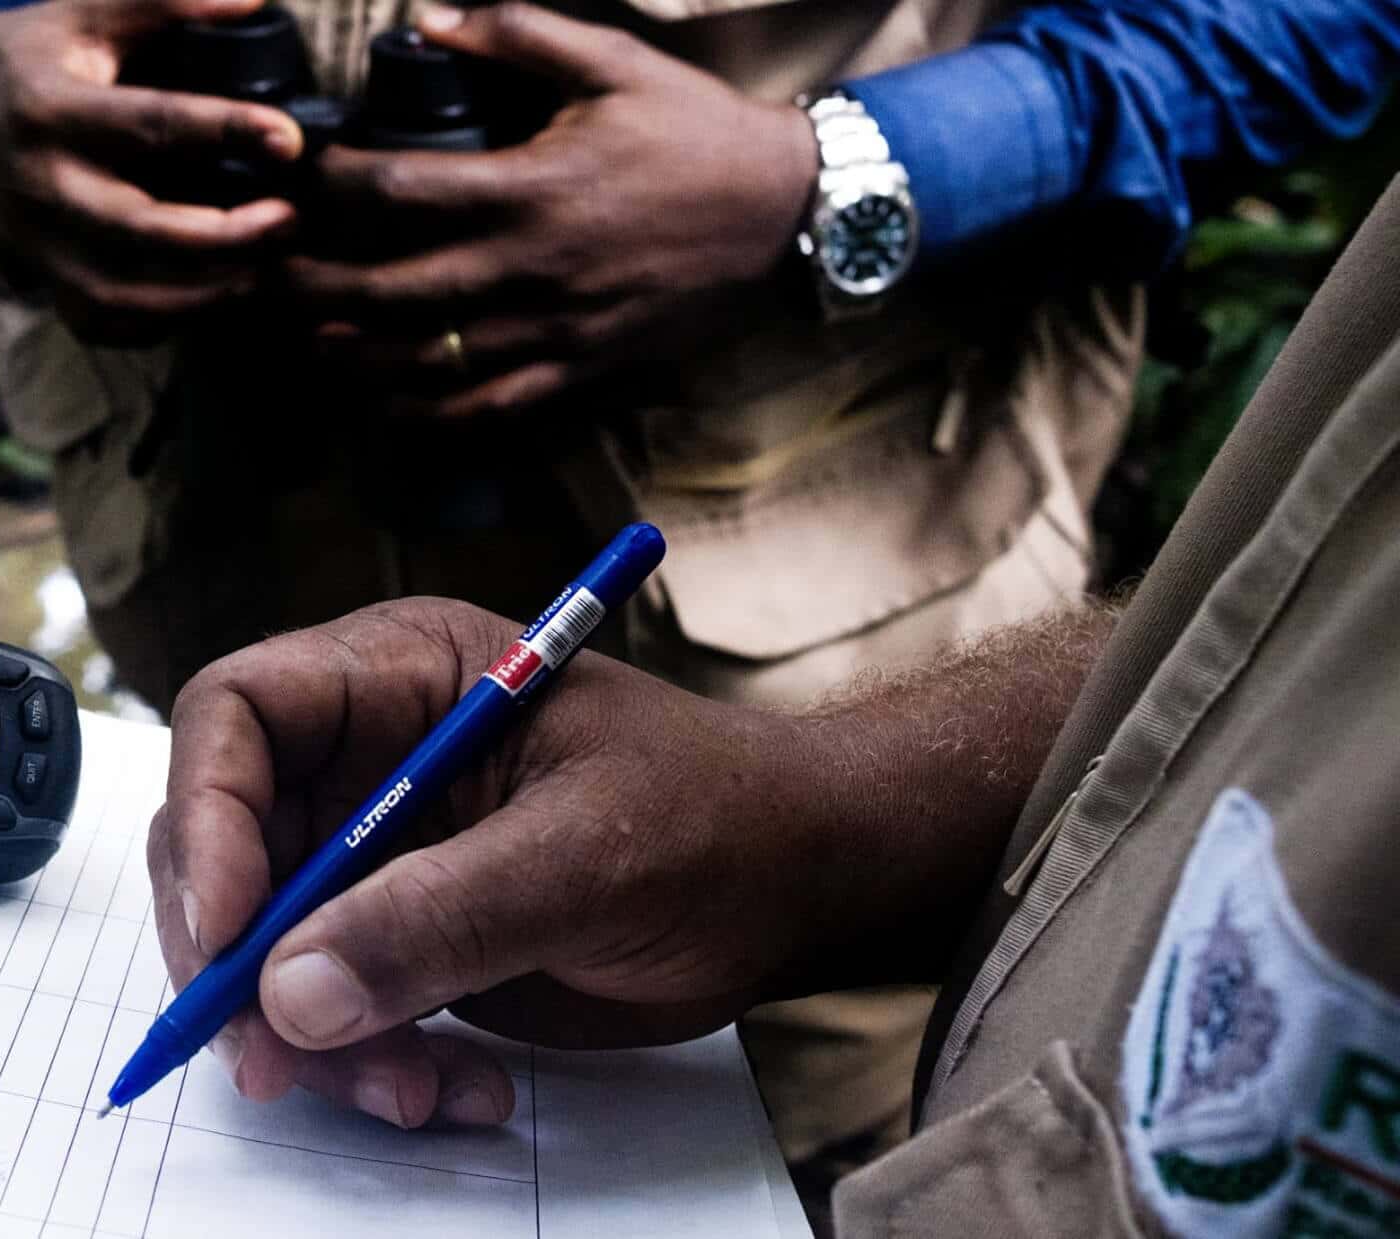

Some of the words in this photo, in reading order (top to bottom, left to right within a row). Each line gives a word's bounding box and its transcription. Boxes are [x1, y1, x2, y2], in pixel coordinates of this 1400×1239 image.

[522, 586, 574, 638] ULTRON
[495, 645, 532, 680] Trio
[26, 762, 37, 784] QUIT
[344, 776, 412, 848] ULTRON
